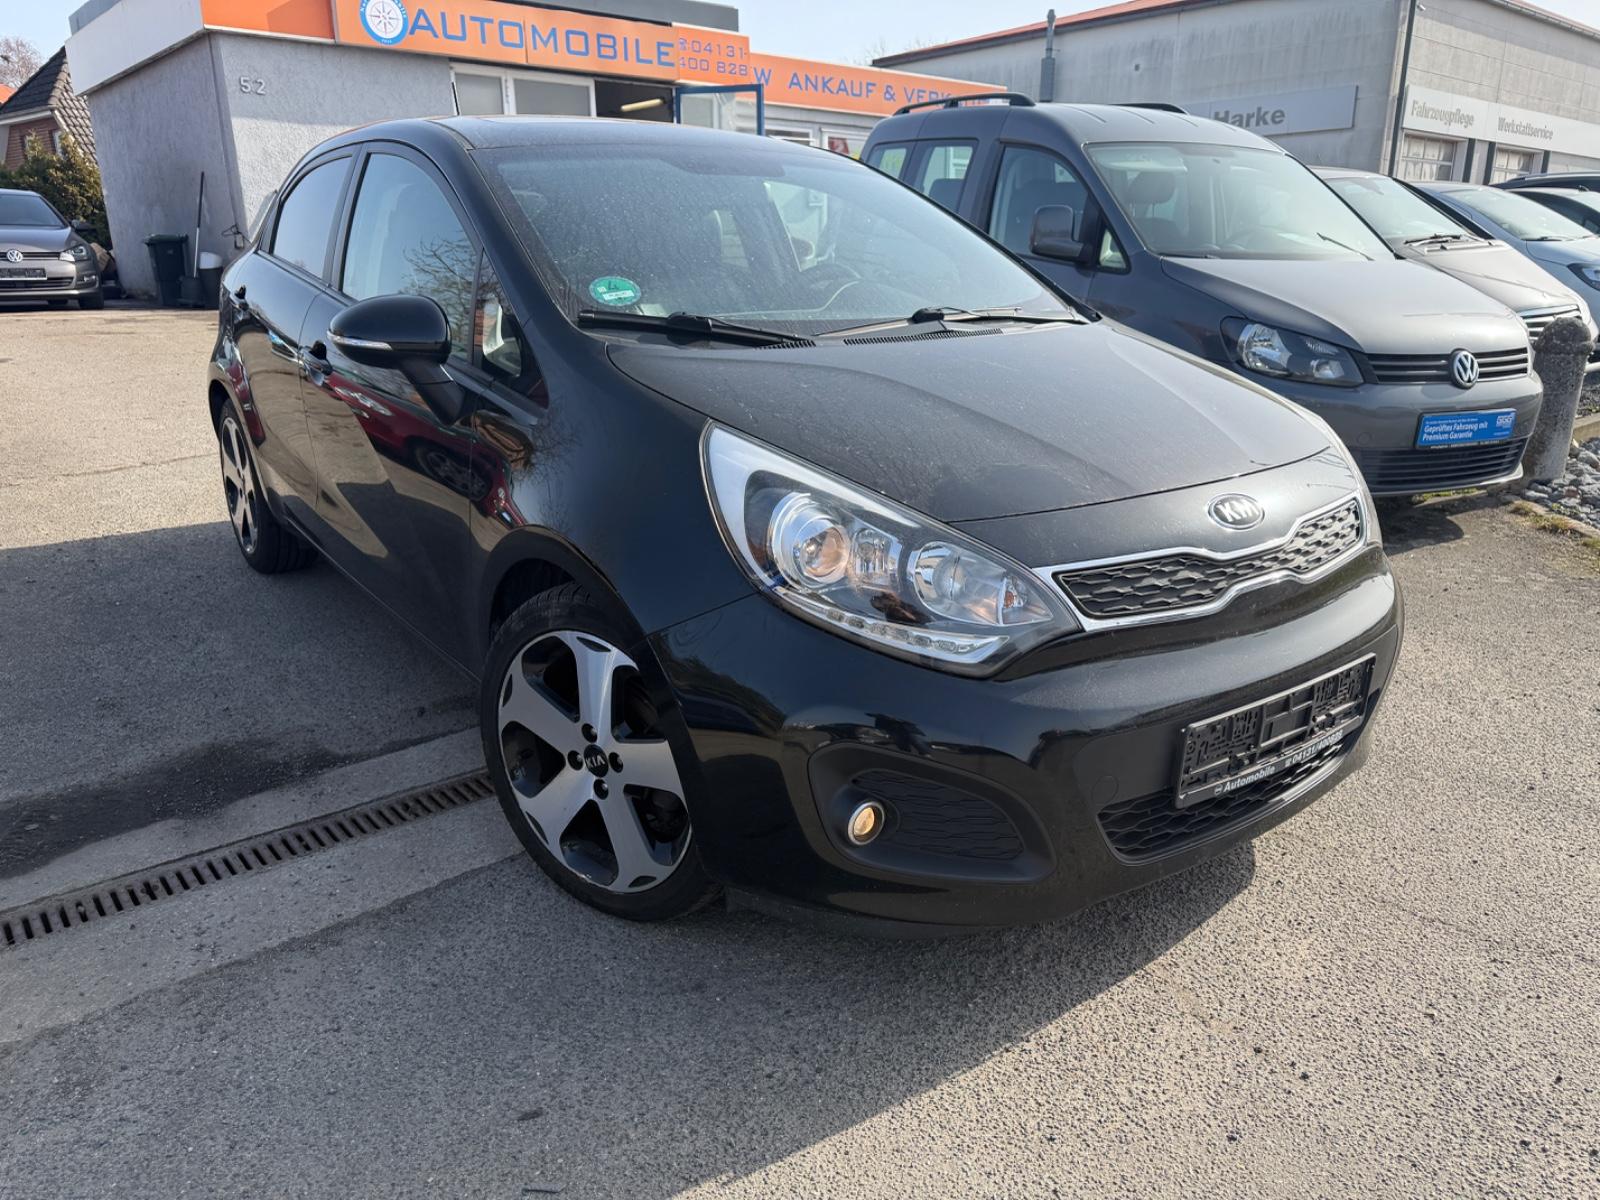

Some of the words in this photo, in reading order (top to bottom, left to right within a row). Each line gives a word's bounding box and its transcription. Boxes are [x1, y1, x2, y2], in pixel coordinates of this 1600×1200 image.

[409, 8, 676, 68] AUTOMOBILE
[716, 61, 748, 76] 828
[239, 76, 266, 95] 52
[788, 72, 878, 98] ANKAUF
[883, 85, 896, 101] &
[1214, 106, 1285, 128] Harke
[1411, 100, 1475, 129] Fahrzeugpflege
[1498, 116, 1554, 140] Werkstattservice
[1422, 432, 1449, 442] Premium
[1449, 430, 1473, 440] Garantie
[1223, 765, 1277, 793] Automobile
